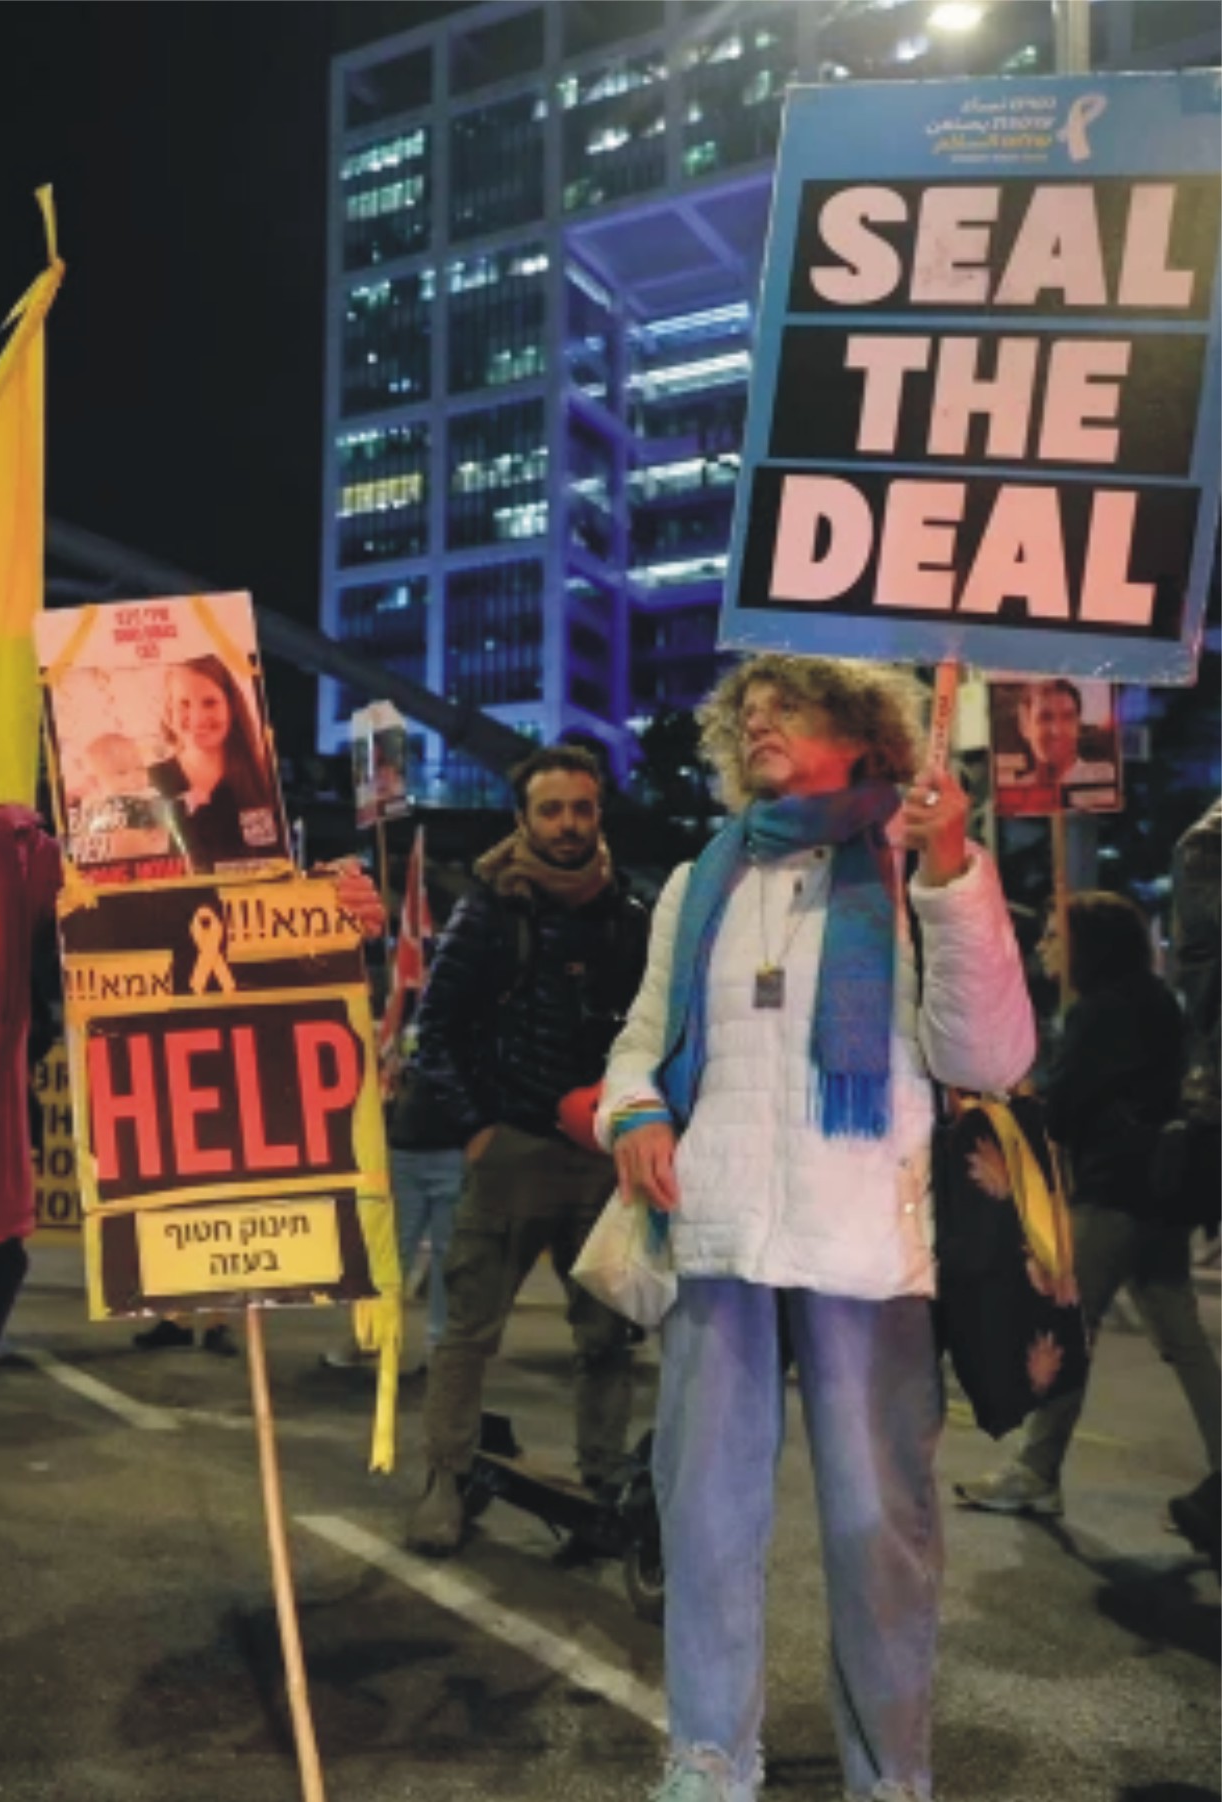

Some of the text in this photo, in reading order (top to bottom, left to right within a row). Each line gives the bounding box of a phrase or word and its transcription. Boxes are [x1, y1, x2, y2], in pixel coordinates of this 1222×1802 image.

[808, 182, 1195, 310] SEAL
[843, 335, 1133, 464] THE
[767, 473, 1158, 627] DEAL
[88, 1019, 362, 1181] HELP
[164, 1215, 311, 1251] תינוק חטוף
[209, 1250, 280, 1276] בעזה
